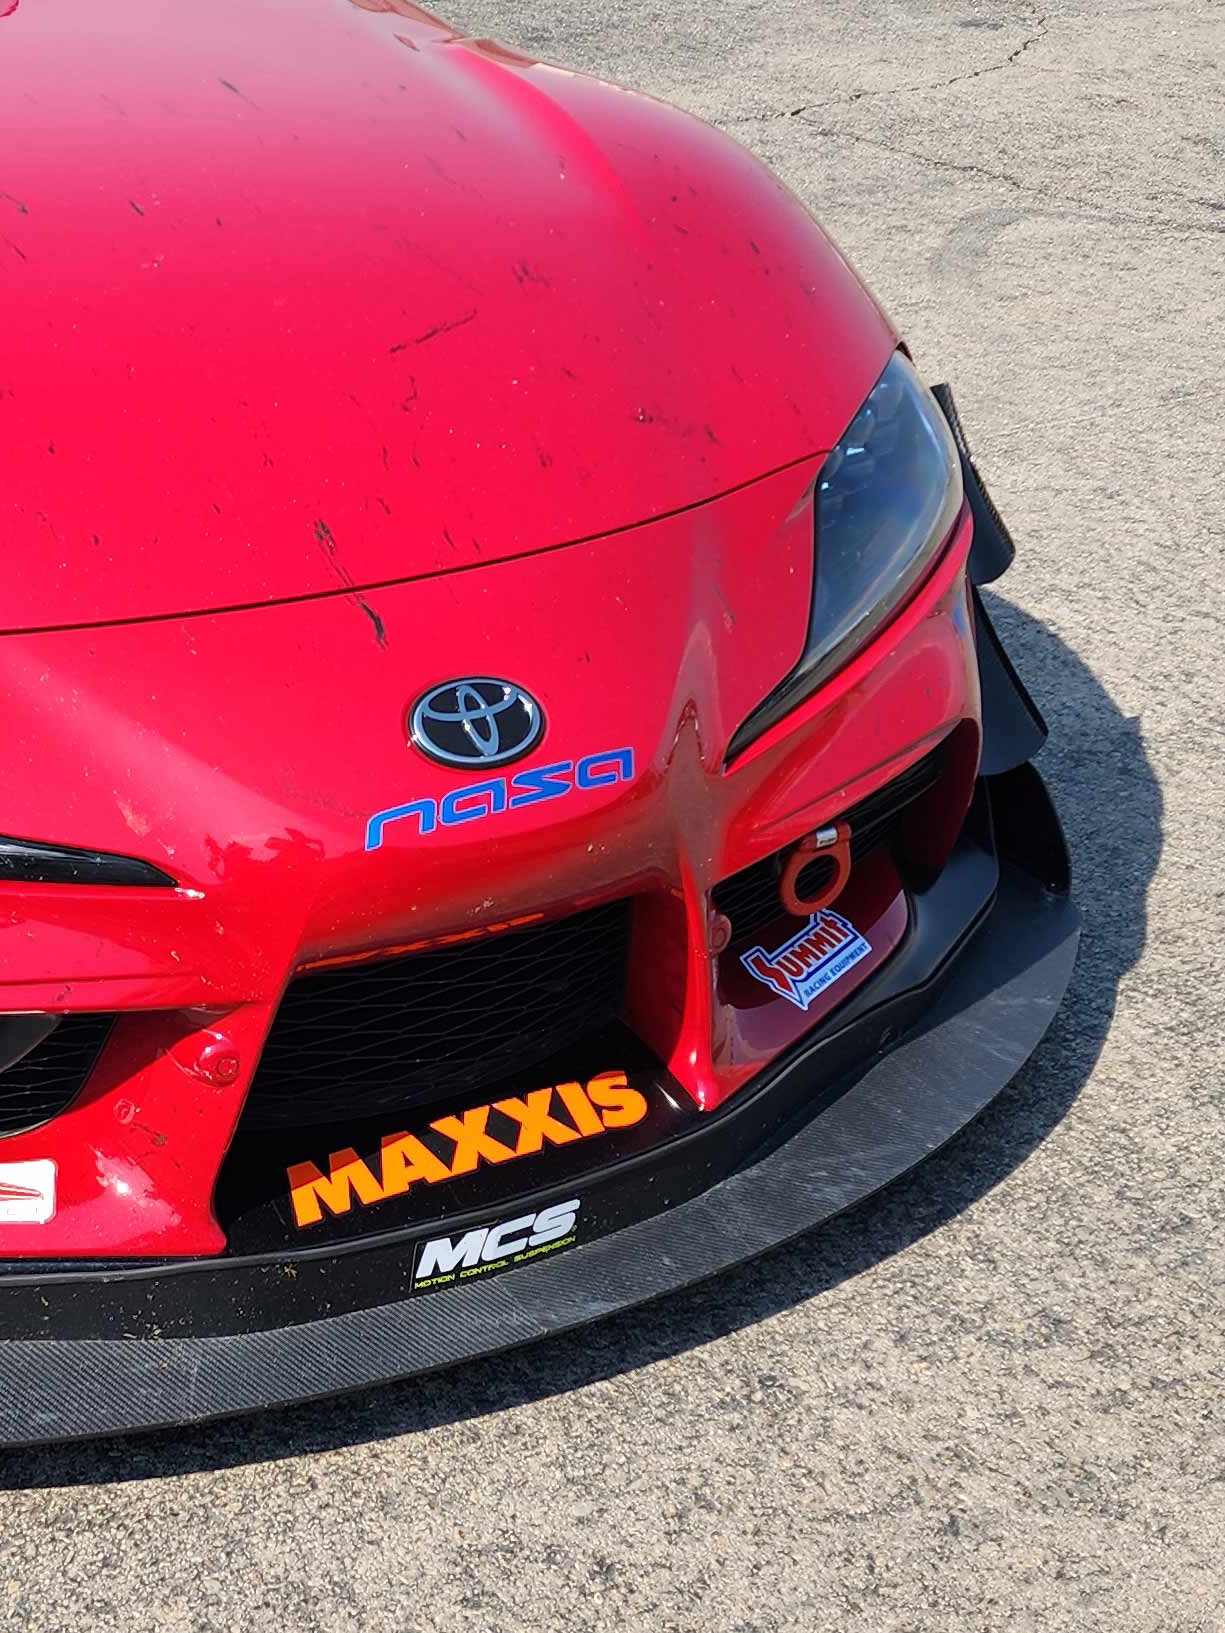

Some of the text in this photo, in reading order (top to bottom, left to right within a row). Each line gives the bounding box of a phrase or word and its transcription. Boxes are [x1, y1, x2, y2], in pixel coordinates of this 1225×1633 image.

[364, 746, 634, 852] nasa
[287, 1070, 648, 1228] MAXXIS
[414, 1235, 576, 1290] MOTION CONTROL SUSPENSION
[415, 1198, 581, 1279] MCS
